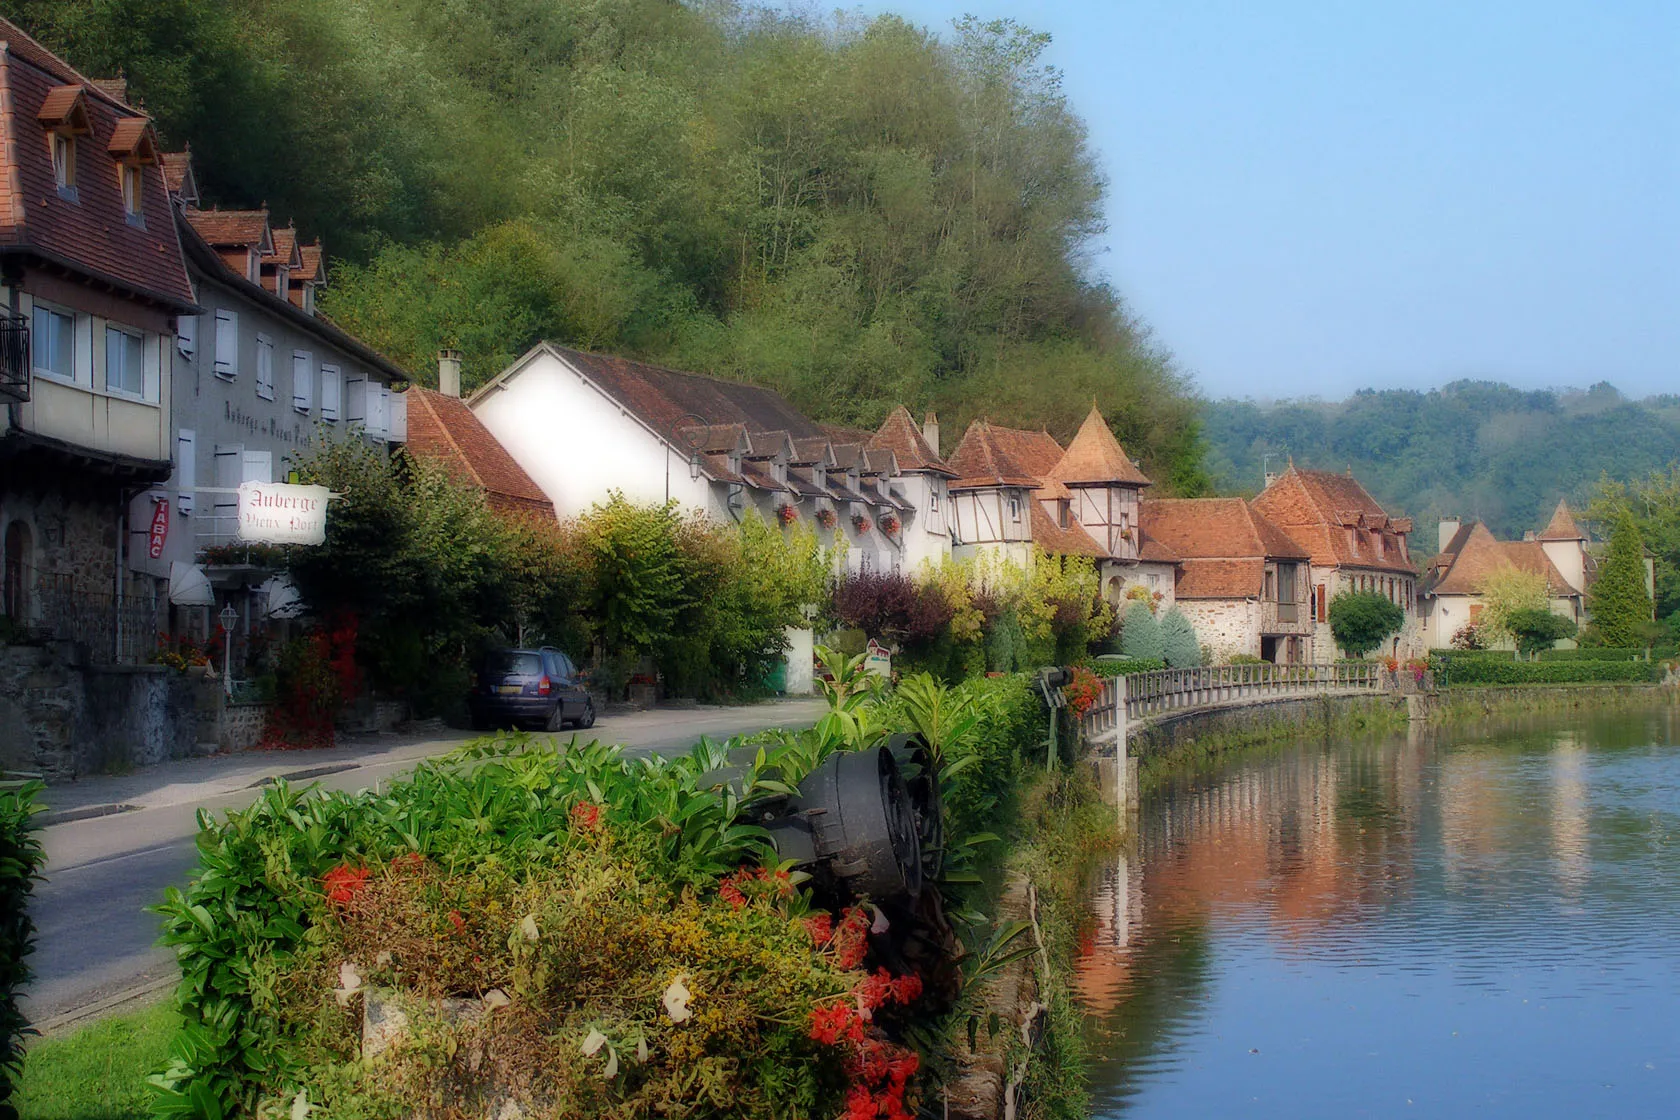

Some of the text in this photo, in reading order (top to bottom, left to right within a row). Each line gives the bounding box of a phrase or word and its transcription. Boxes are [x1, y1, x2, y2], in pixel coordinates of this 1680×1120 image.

[250, 489, 318, 513] Auberge
[151, 501, 168, 556] TABAC
[246, 513, 319, 532] Vieux Port
